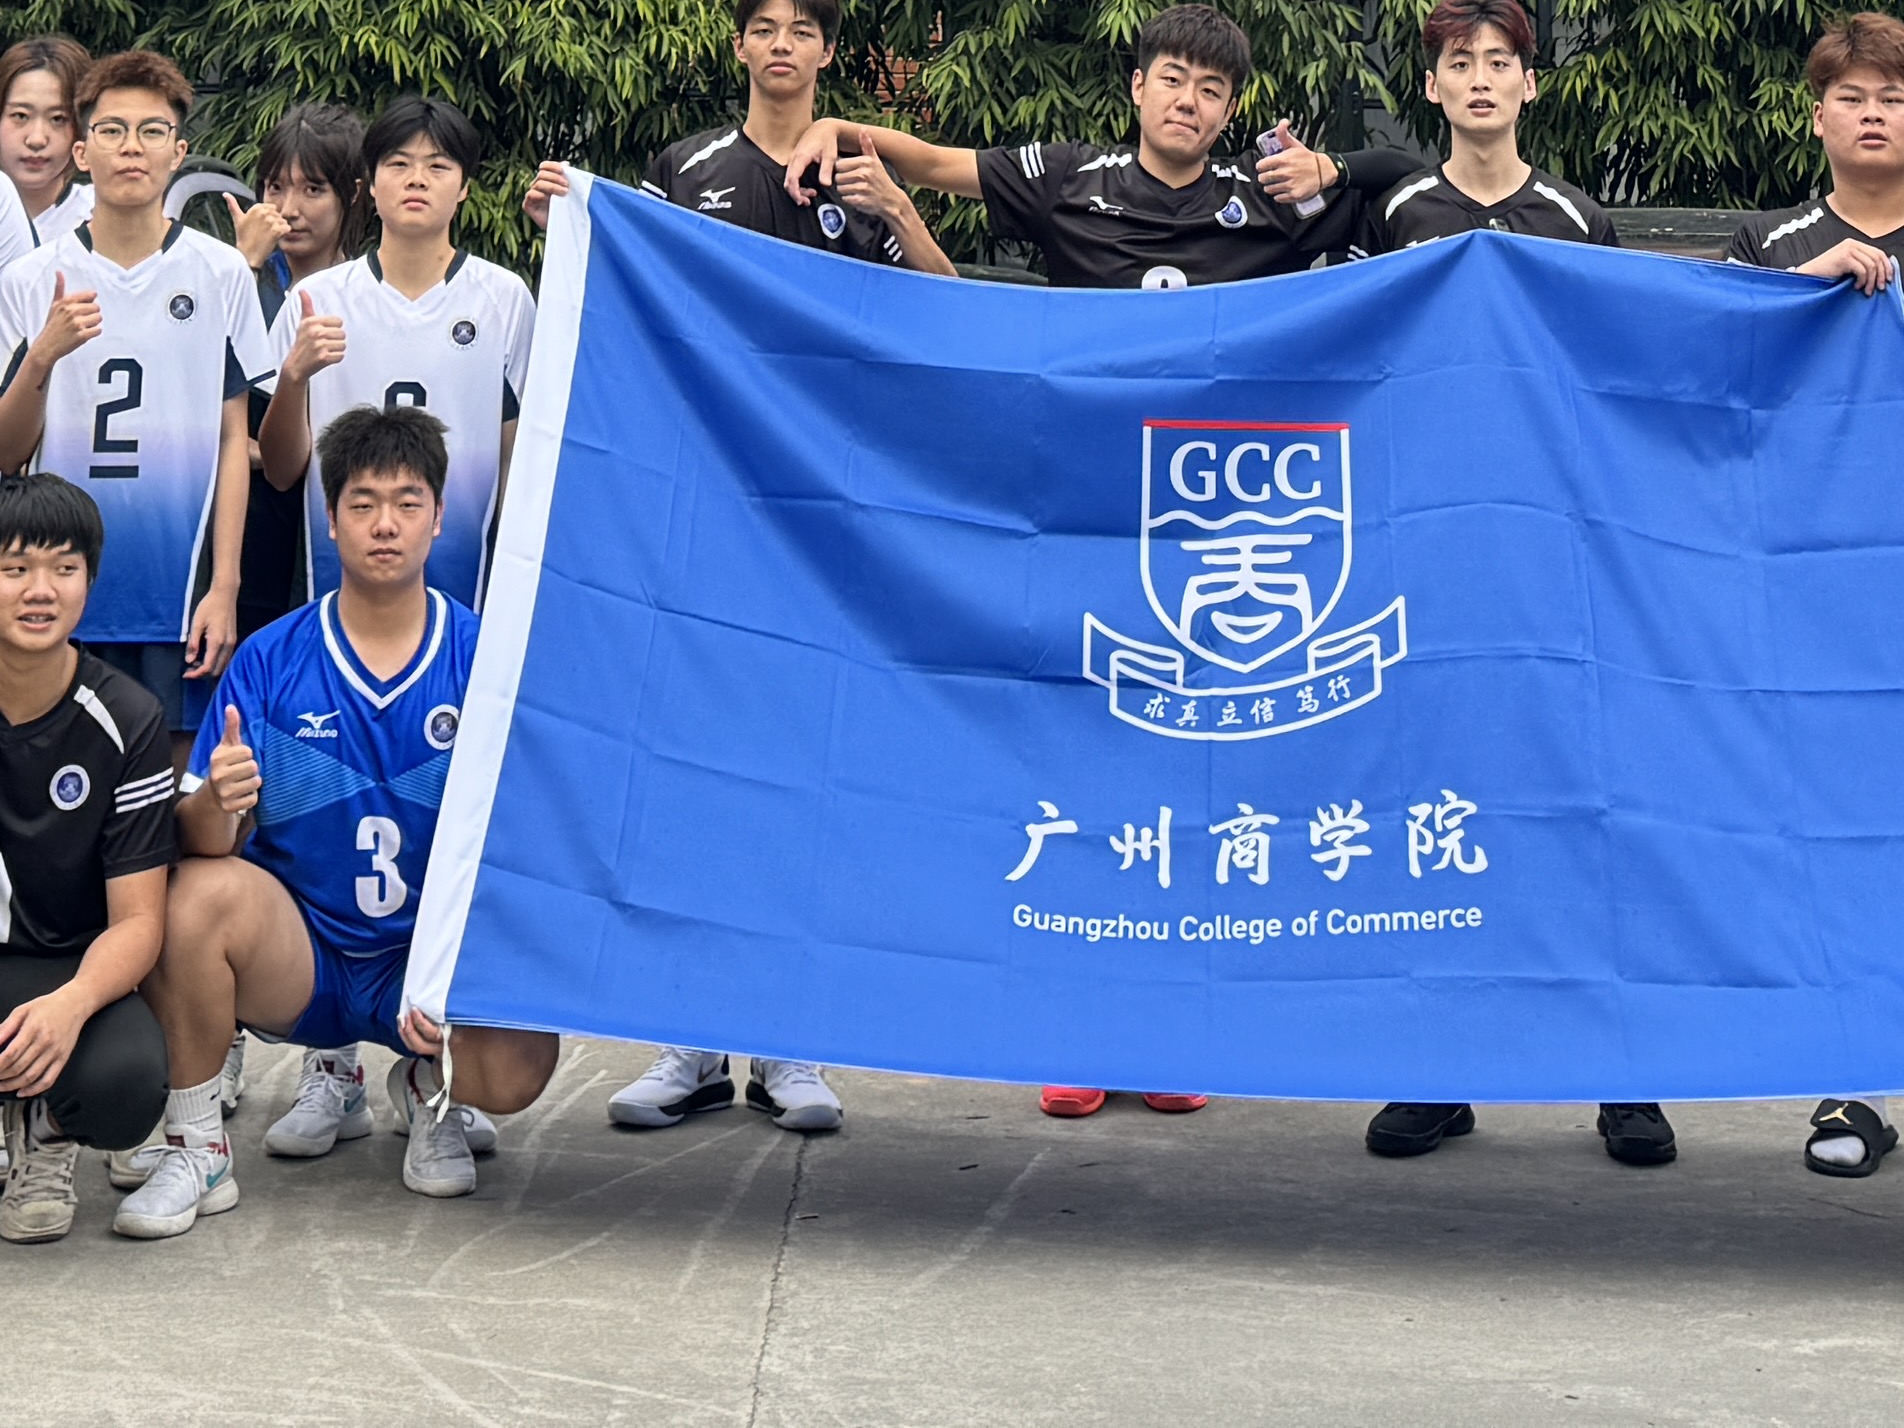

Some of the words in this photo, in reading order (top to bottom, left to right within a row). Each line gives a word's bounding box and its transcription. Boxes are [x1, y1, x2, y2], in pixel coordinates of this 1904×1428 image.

[93, 358, 143, 453] 2
[1169, 440, 1322, 503] GCC
[354, 816, 407, 918] 3
[1004, 789, 1488, 889] 广州商学院
[1013, 904, 1169, 942] Guangzhou
[1179, 914, 1282, 944] College
[1295, 910, 1319, 936] of
[1326, 906, 1482, 934] Commerce
